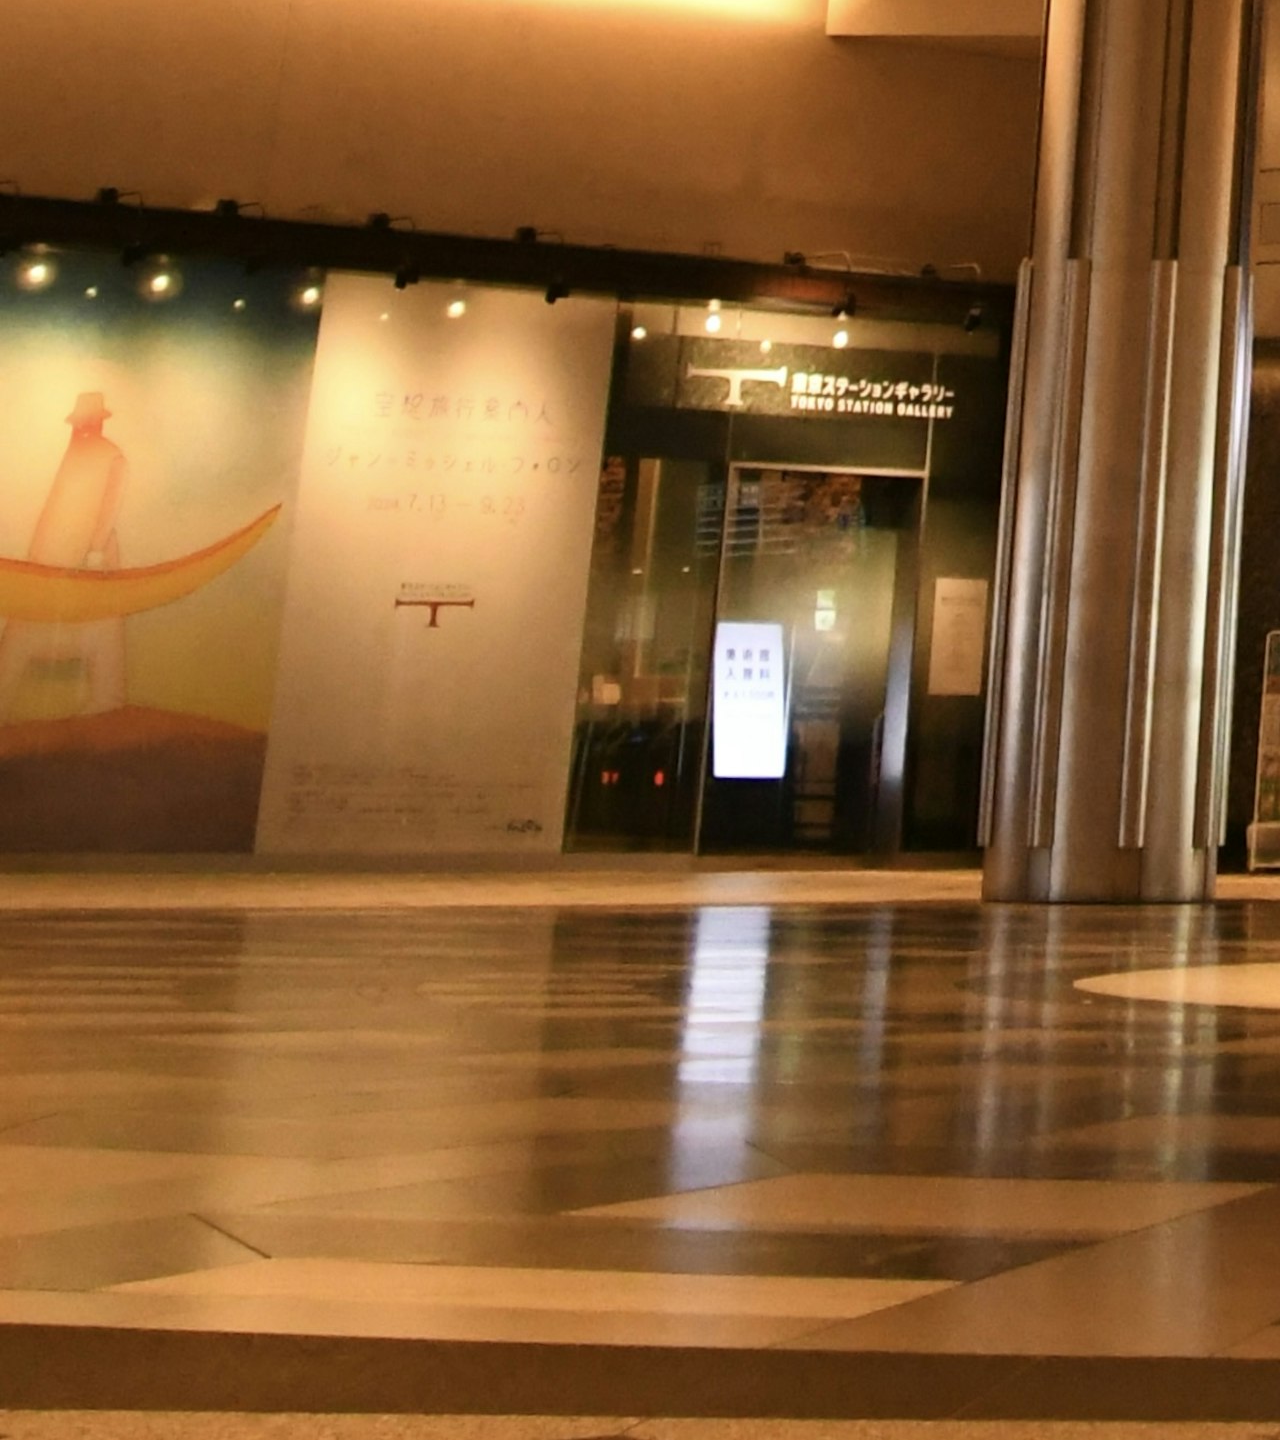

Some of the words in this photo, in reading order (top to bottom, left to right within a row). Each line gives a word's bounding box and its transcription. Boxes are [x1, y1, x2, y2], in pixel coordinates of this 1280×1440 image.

[792, 372, 955, 402] 東京ステーションギャラリー
[790, 395, 834, 412] TOKYO
[838, 399, 893, 416] STATION
[897, 404, 954, 419] GALLERY
